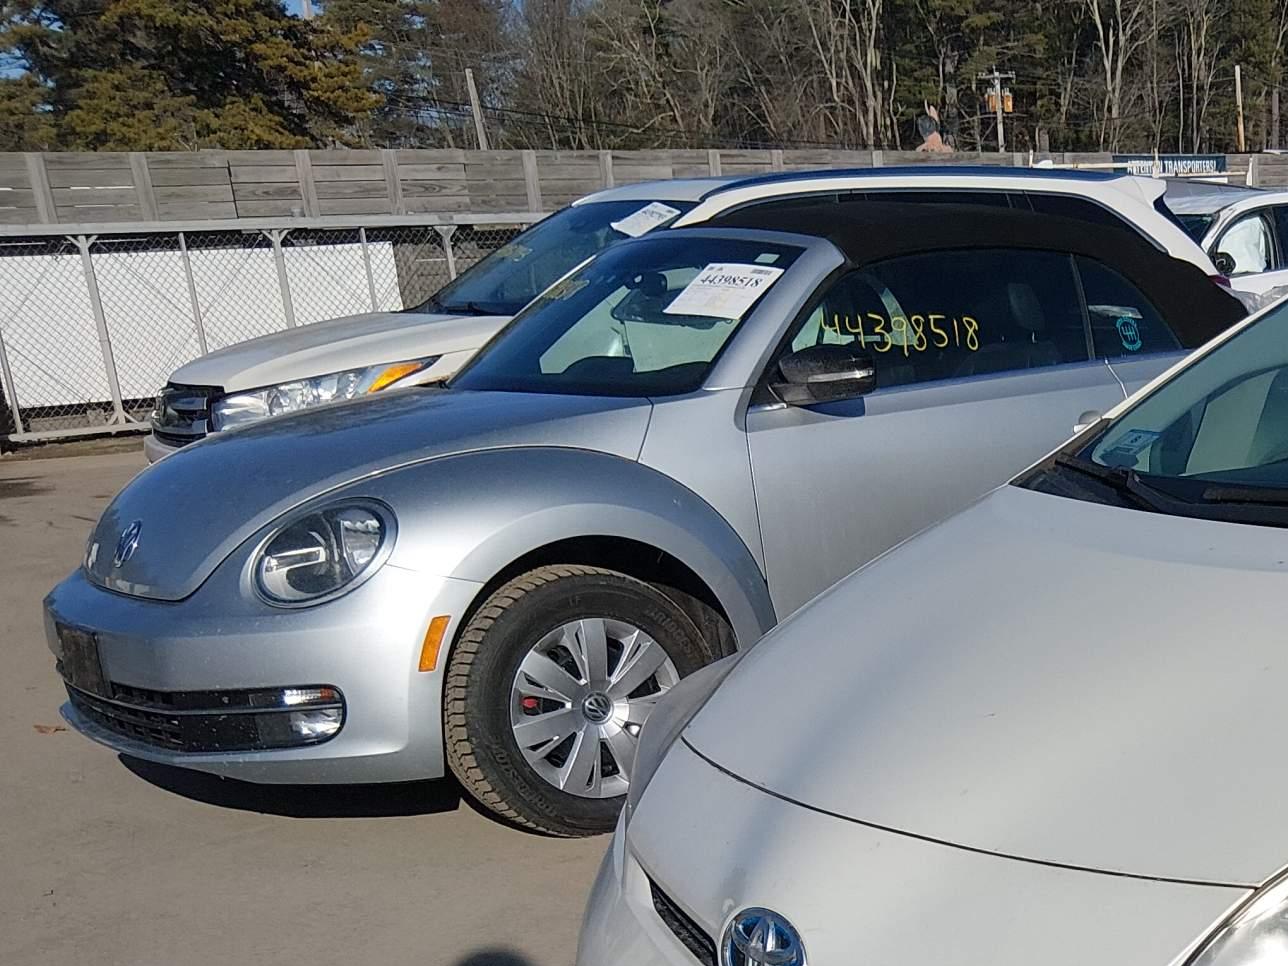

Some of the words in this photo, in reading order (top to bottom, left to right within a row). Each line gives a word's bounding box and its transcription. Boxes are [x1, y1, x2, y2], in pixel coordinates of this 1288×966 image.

[1127, 159, 1163, 175] ATTENTN
[1164, 159, 1217, 174] TRANSPORTERS!
[701, 274, 762, 288] 44398518
[819, 312, 979, 357] 44398518
